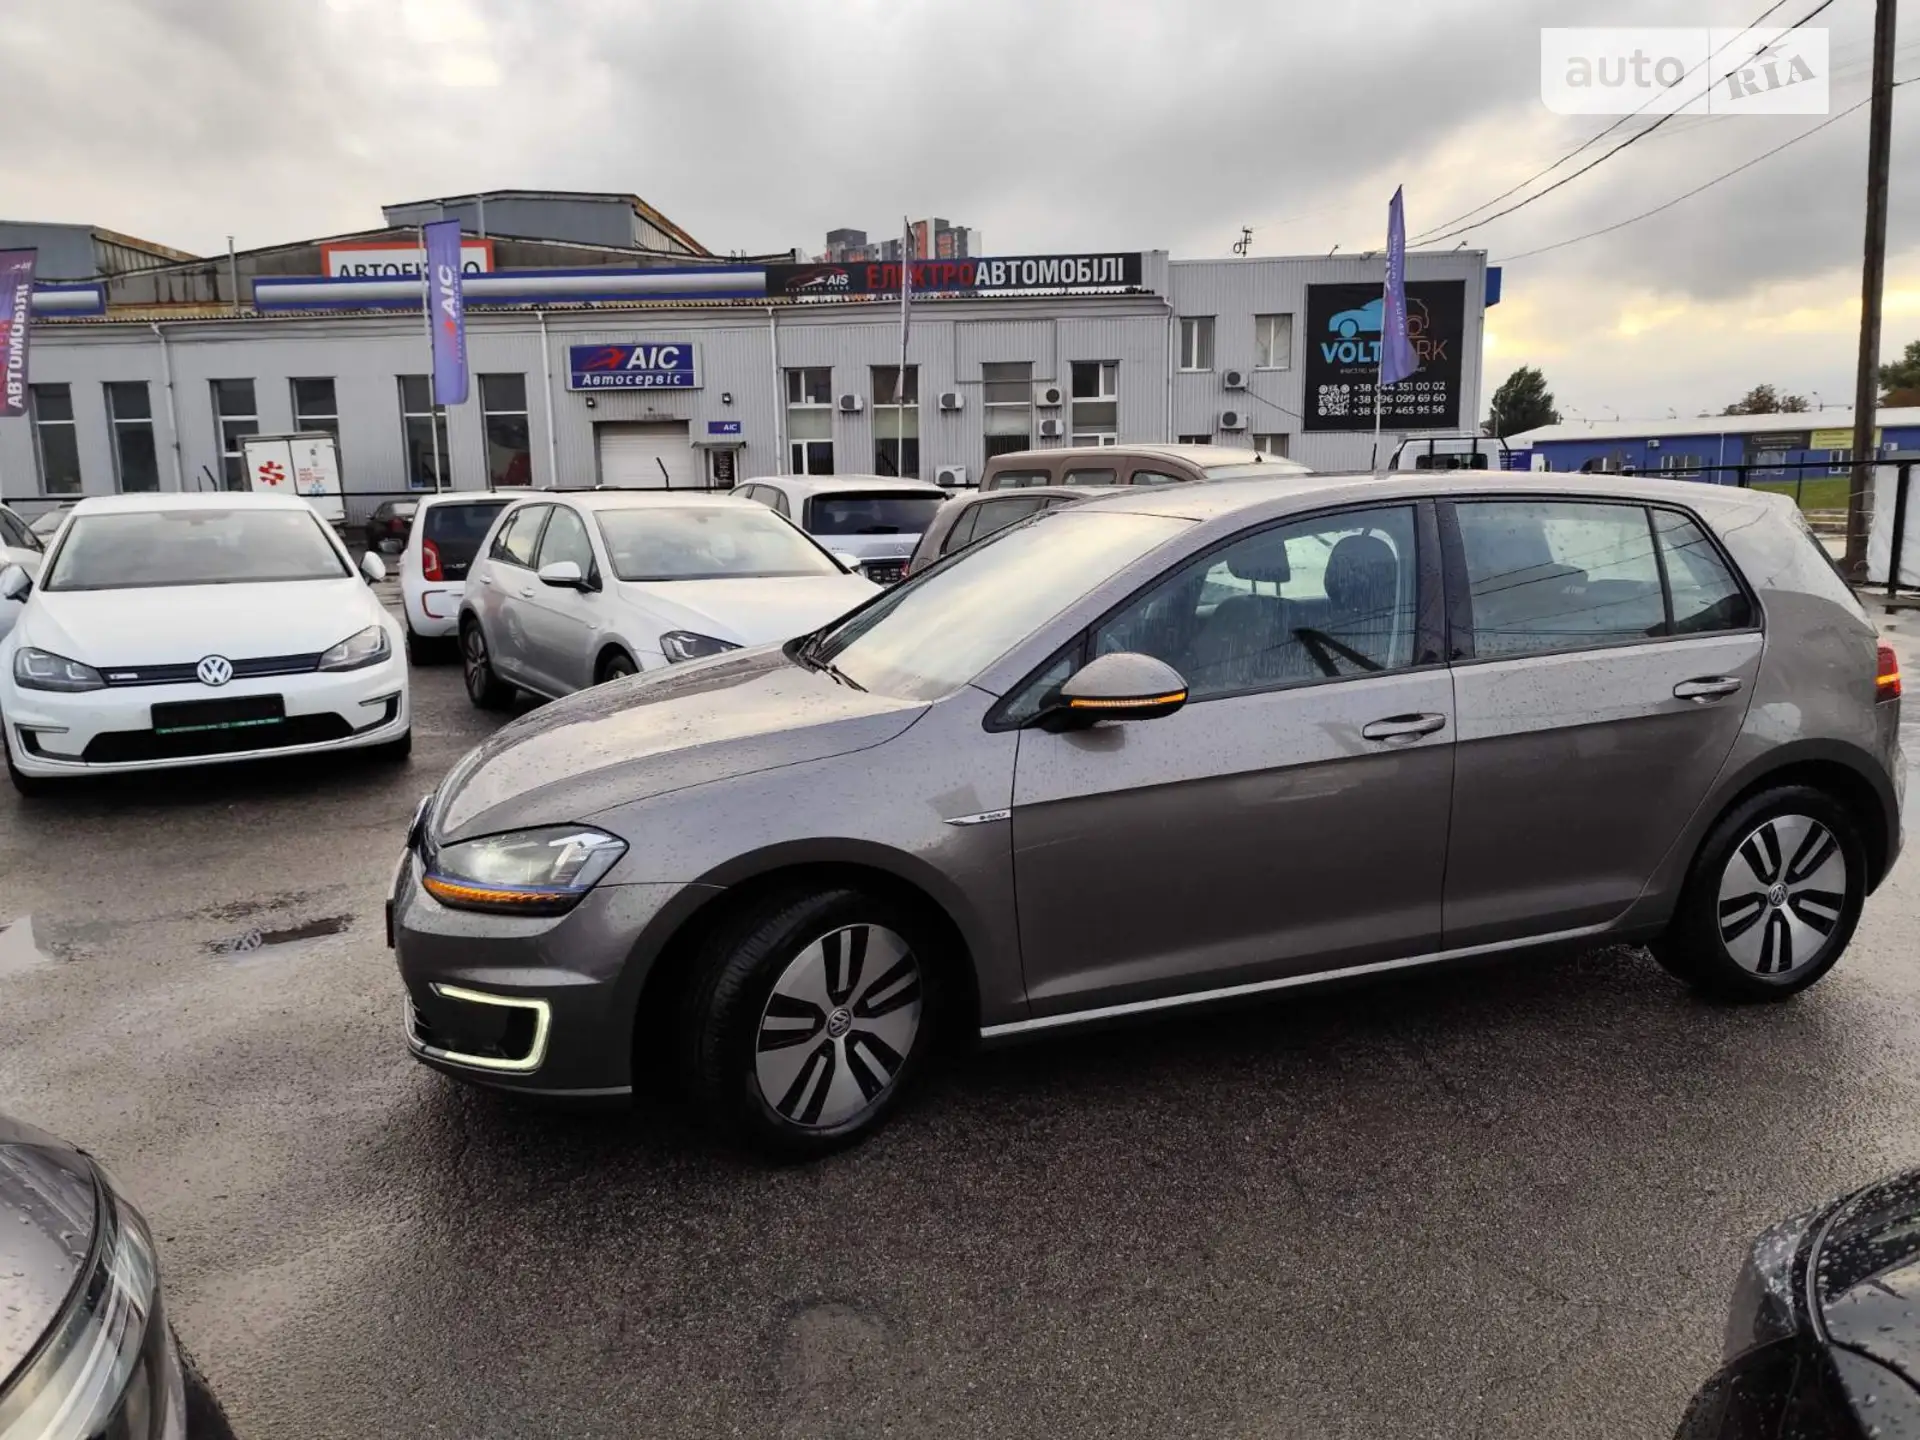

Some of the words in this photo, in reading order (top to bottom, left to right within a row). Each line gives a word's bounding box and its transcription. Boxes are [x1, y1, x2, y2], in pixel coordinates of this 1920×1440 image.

[827, 274, 849, 286] AIS
[1320, 340, 1448, 364] VOLTRK
[582, 373, 681, 387] Автосервіс
[1353, 383, 1372, 392] +38
[1397, 382, 1413, 391] 351
[1416, 382, 1430, 391] 00
[1433, 381, 1446, 391] 02
[1353, 395, 1371, 404] +38
[1396, 394, 1415, 403] 099
[1418, 394, 1431, 402] 69
[1433, 393, 1446, 402] 60
[1352, 407, 1371, 416] +38
[1395, 406, 1415, 415] 465
[1417, 405, 1430, 414] 95
[1432, 405, 1445, 414] 56
